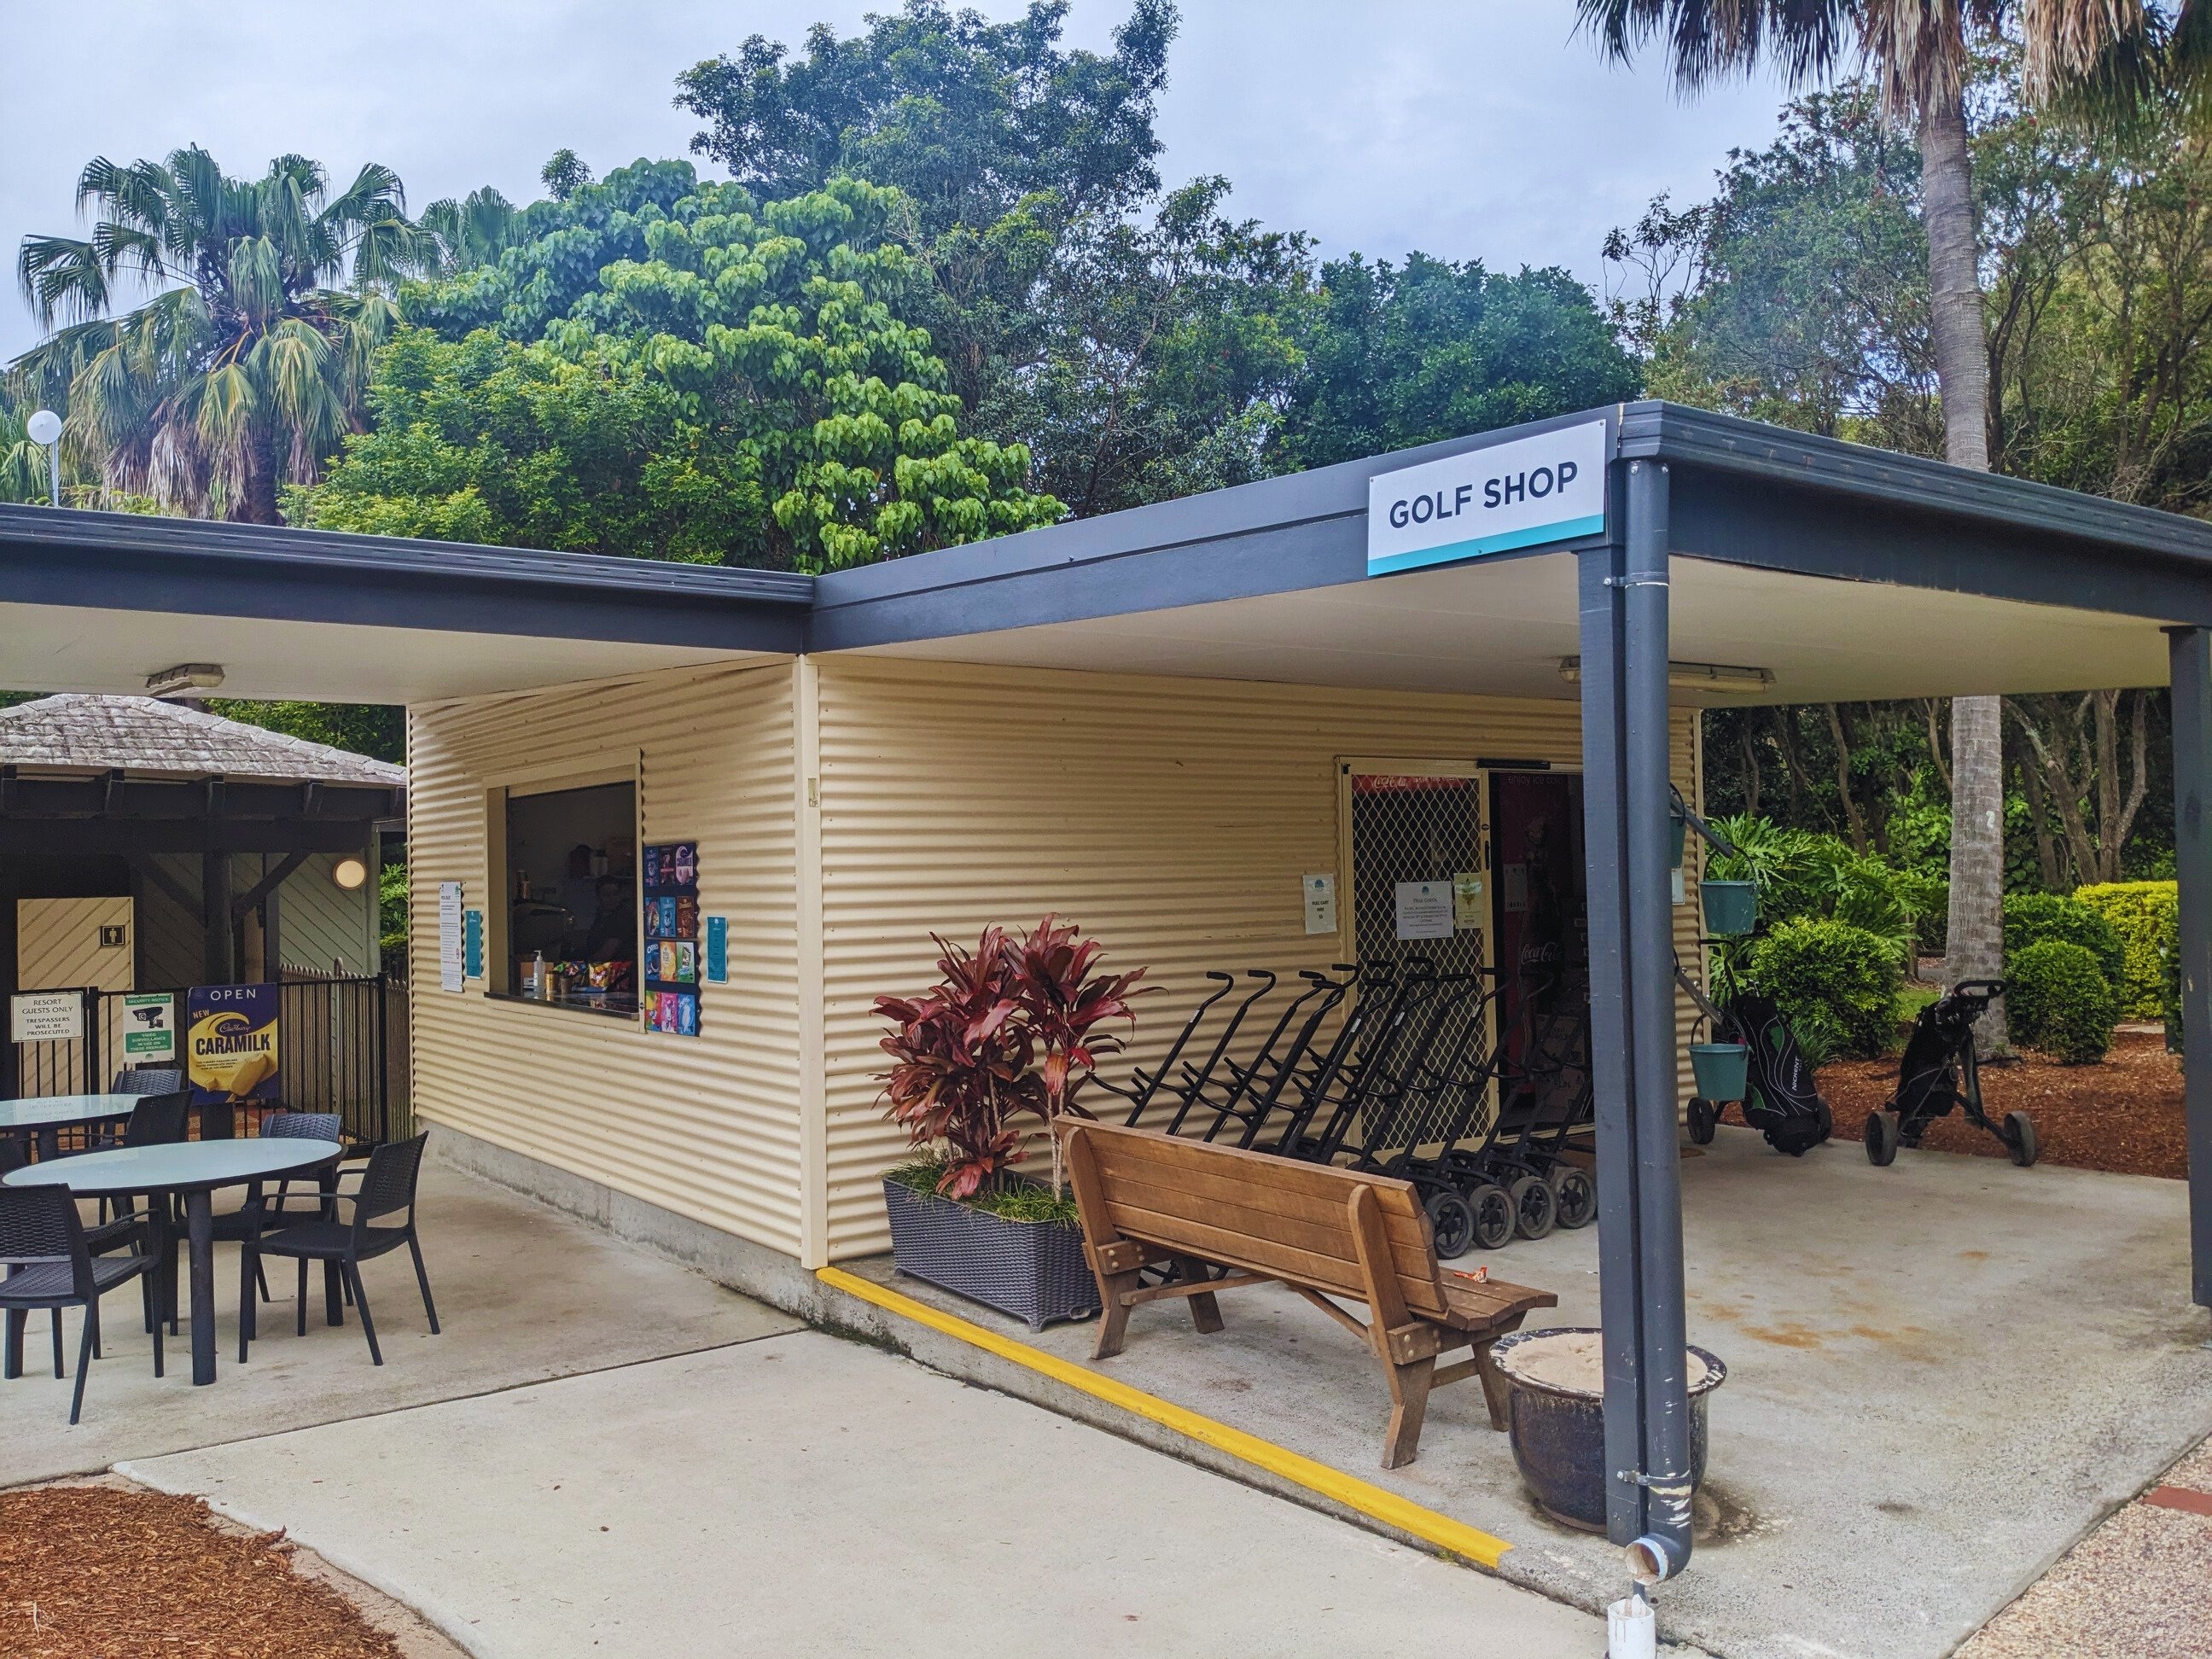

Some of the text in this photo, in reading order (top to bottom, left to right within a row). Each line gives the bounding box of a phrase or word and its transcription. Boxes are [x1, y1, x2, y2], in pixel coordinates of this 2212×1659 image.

[1389, 461, 1578, 529] GOLF SHOP
[210, 988, 256, 1001] OPEN
[192, 1009, 210, 1019] NEW
[219, 1022, 251, 1033] Cadbury
[195, 1033, 271, 1056] CARAMILK
